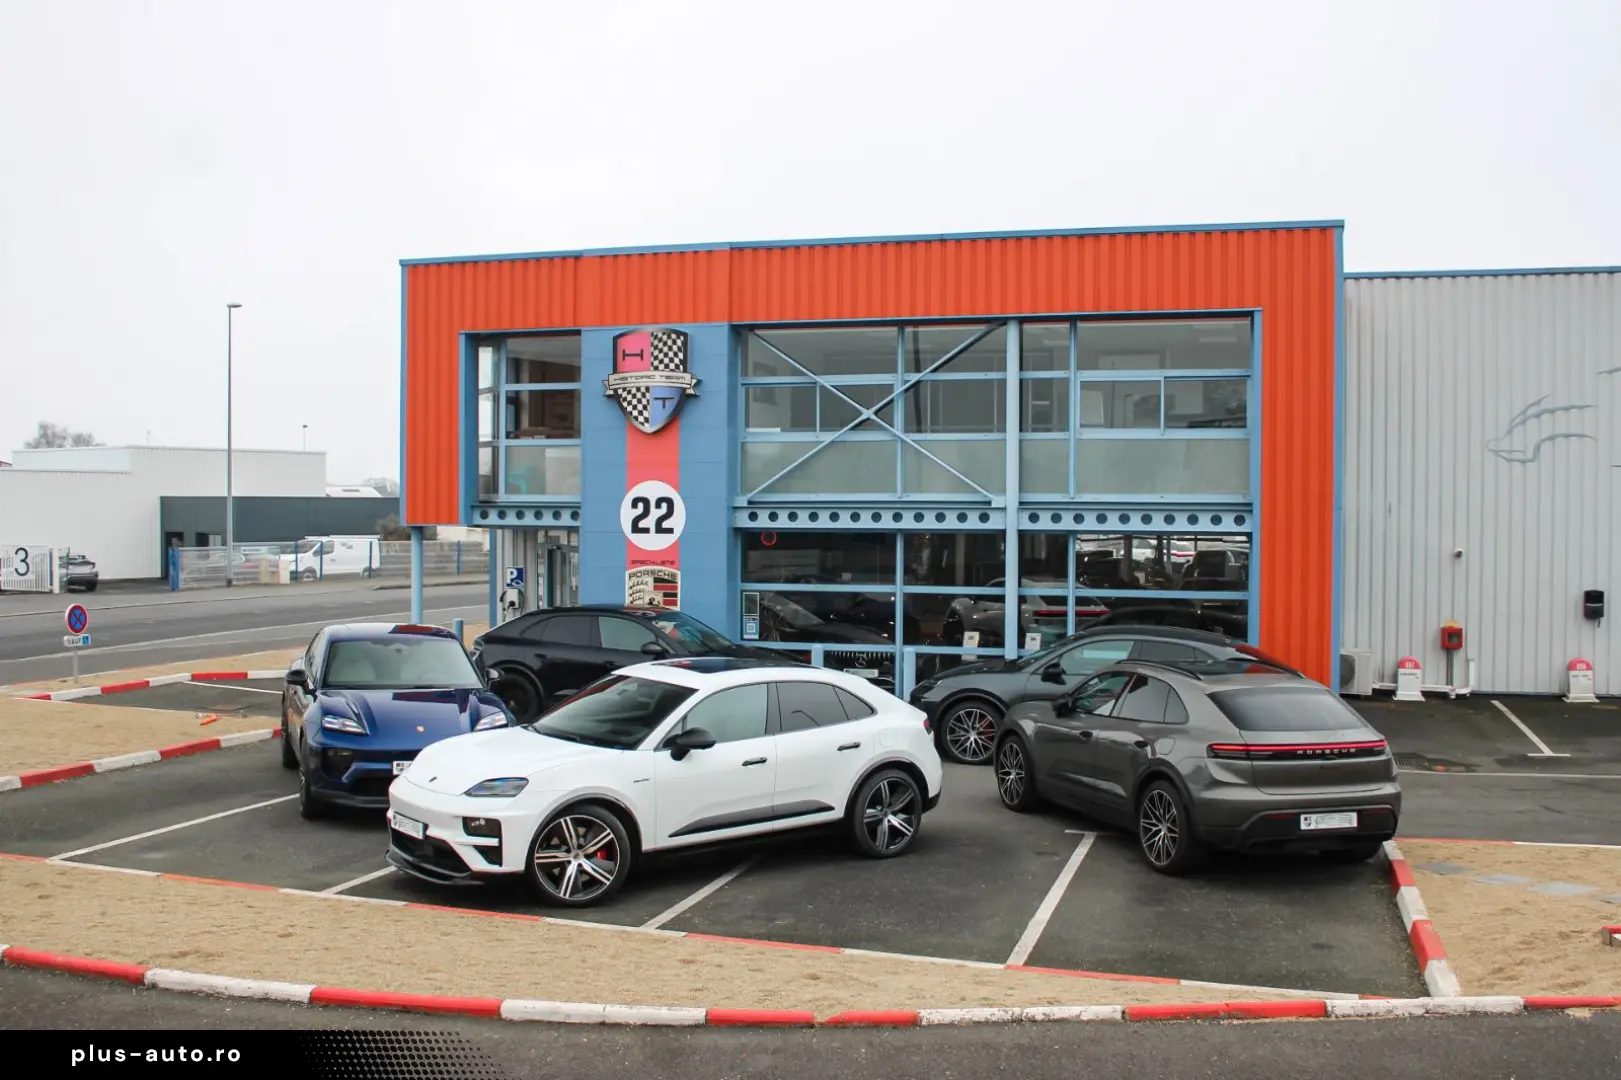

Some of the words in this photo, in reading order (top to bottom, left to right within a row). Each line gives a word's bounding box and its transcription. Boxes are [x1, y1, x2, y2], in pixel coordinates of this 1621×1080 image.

[622, 348, 644, 362] H
[659, 374, 686, 382] TEAM
[653, 397, 675, 409] T
[631, 496, 675, 534] 22
[14, 547, 30, 577] 3
[506, 568, 518, 584] P
[628, 569, 678, 581] PORSCHE
